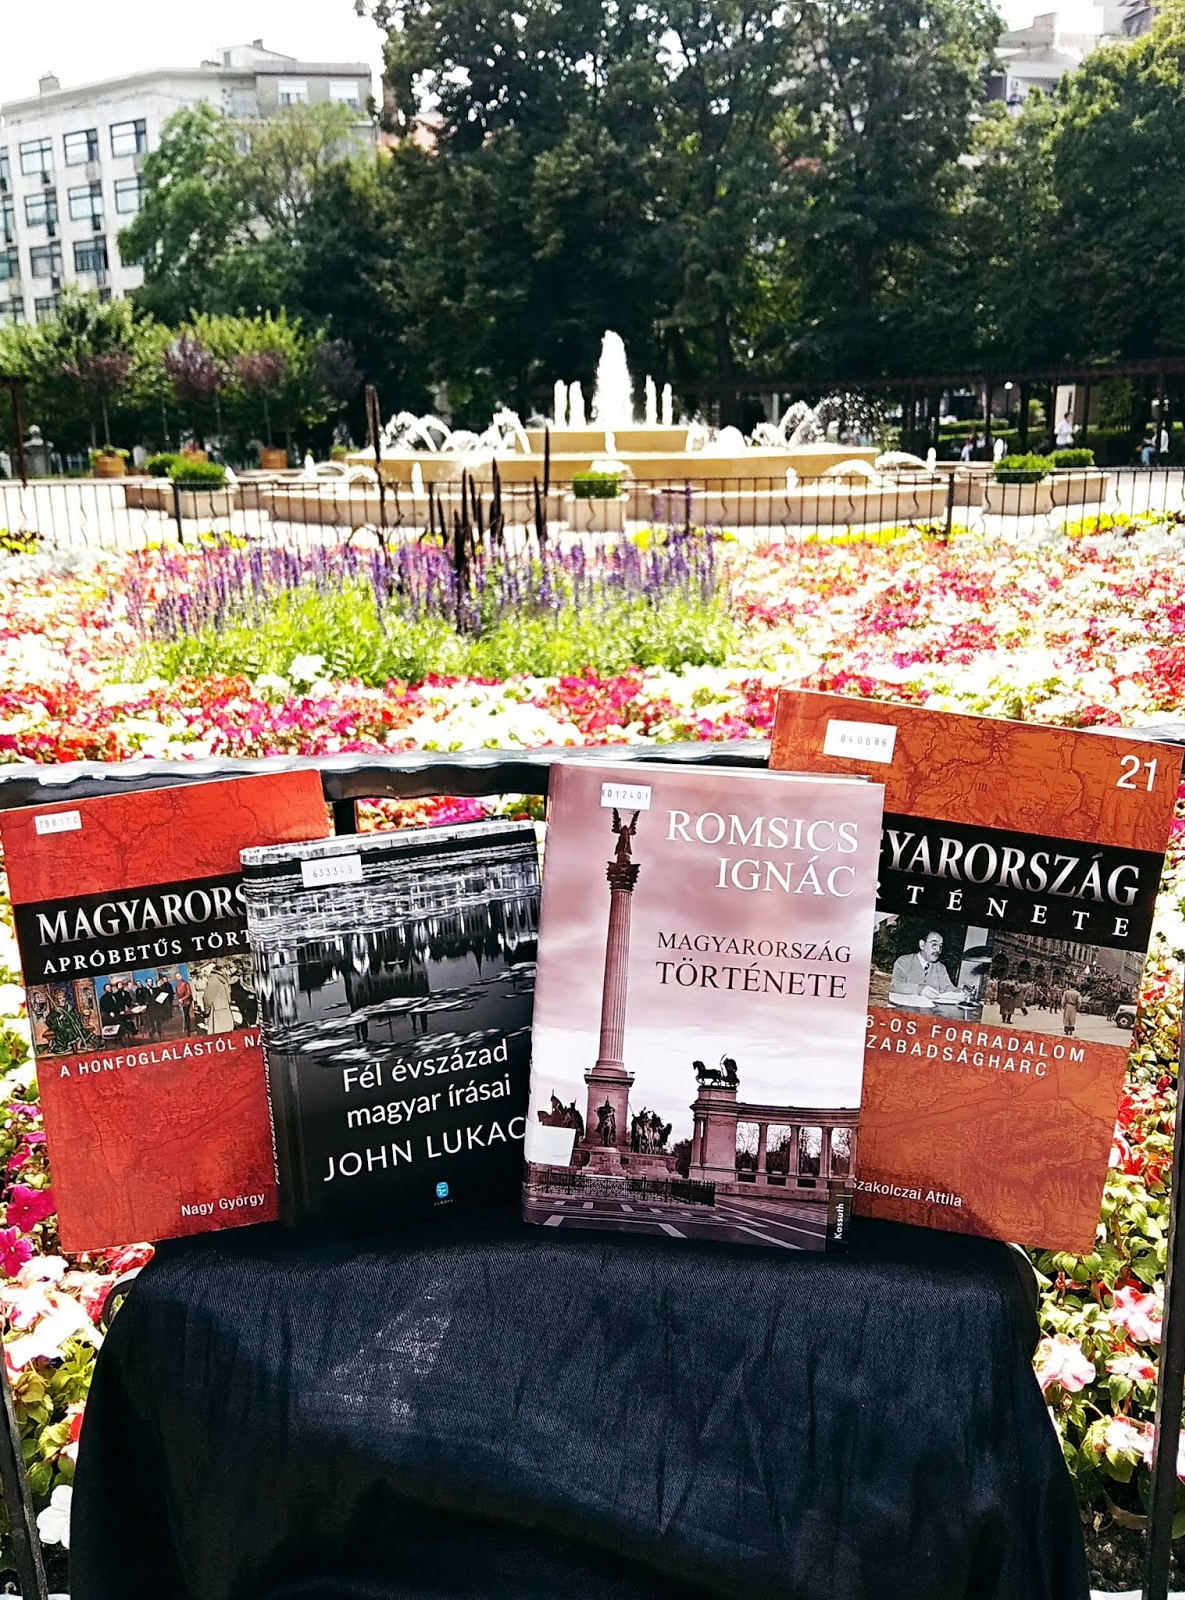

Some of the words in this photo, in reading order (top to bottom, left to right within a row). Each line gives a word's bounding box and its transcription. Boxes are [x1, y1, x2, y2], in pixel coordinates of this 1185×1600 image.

[1116, 753, 1159, 792] 21
[665, 809, 858, 853] ROMSICS
[715, 854, 856, 897] IGNÁC
[880, 828, 1140, 907] YARORSZÁG
[36, 883, 246, 946] MAGYARORS
[43, 937, 183, 974] APRÓBETŰS
[192, 929, 250, 951] TÖRT
[657, 931, 851, 963] MAGYARORSZÁG
[655, 957, 847, 999] TÖRTÉNETE
[60, 1065, 70, 1078] A
[79, 1036, 237, 1075] HONFOGLALÁSTÓL
[866, 1034, 1047, 1077] ZABADSÁGHARC
[931, 1024, 1085, 1063] FORRADALOM
[343, 1062, 382, 1093] Fél
[392, 1038, 508, 1083] évszázad
[347, 1093, 442, 1128] magyar
[448, 1073, 511, 1109] írásai
[323, 1138, 413, 1183] JOHN
[426, 1116, 526, 1160] LUKAC
[181, 1201, 214, 1217] Nagy
[219, 1193, 265, 1214] György
[925, 1190, 962, 1207] Attila
[834, 1203, 845, 1240] Kossuth
